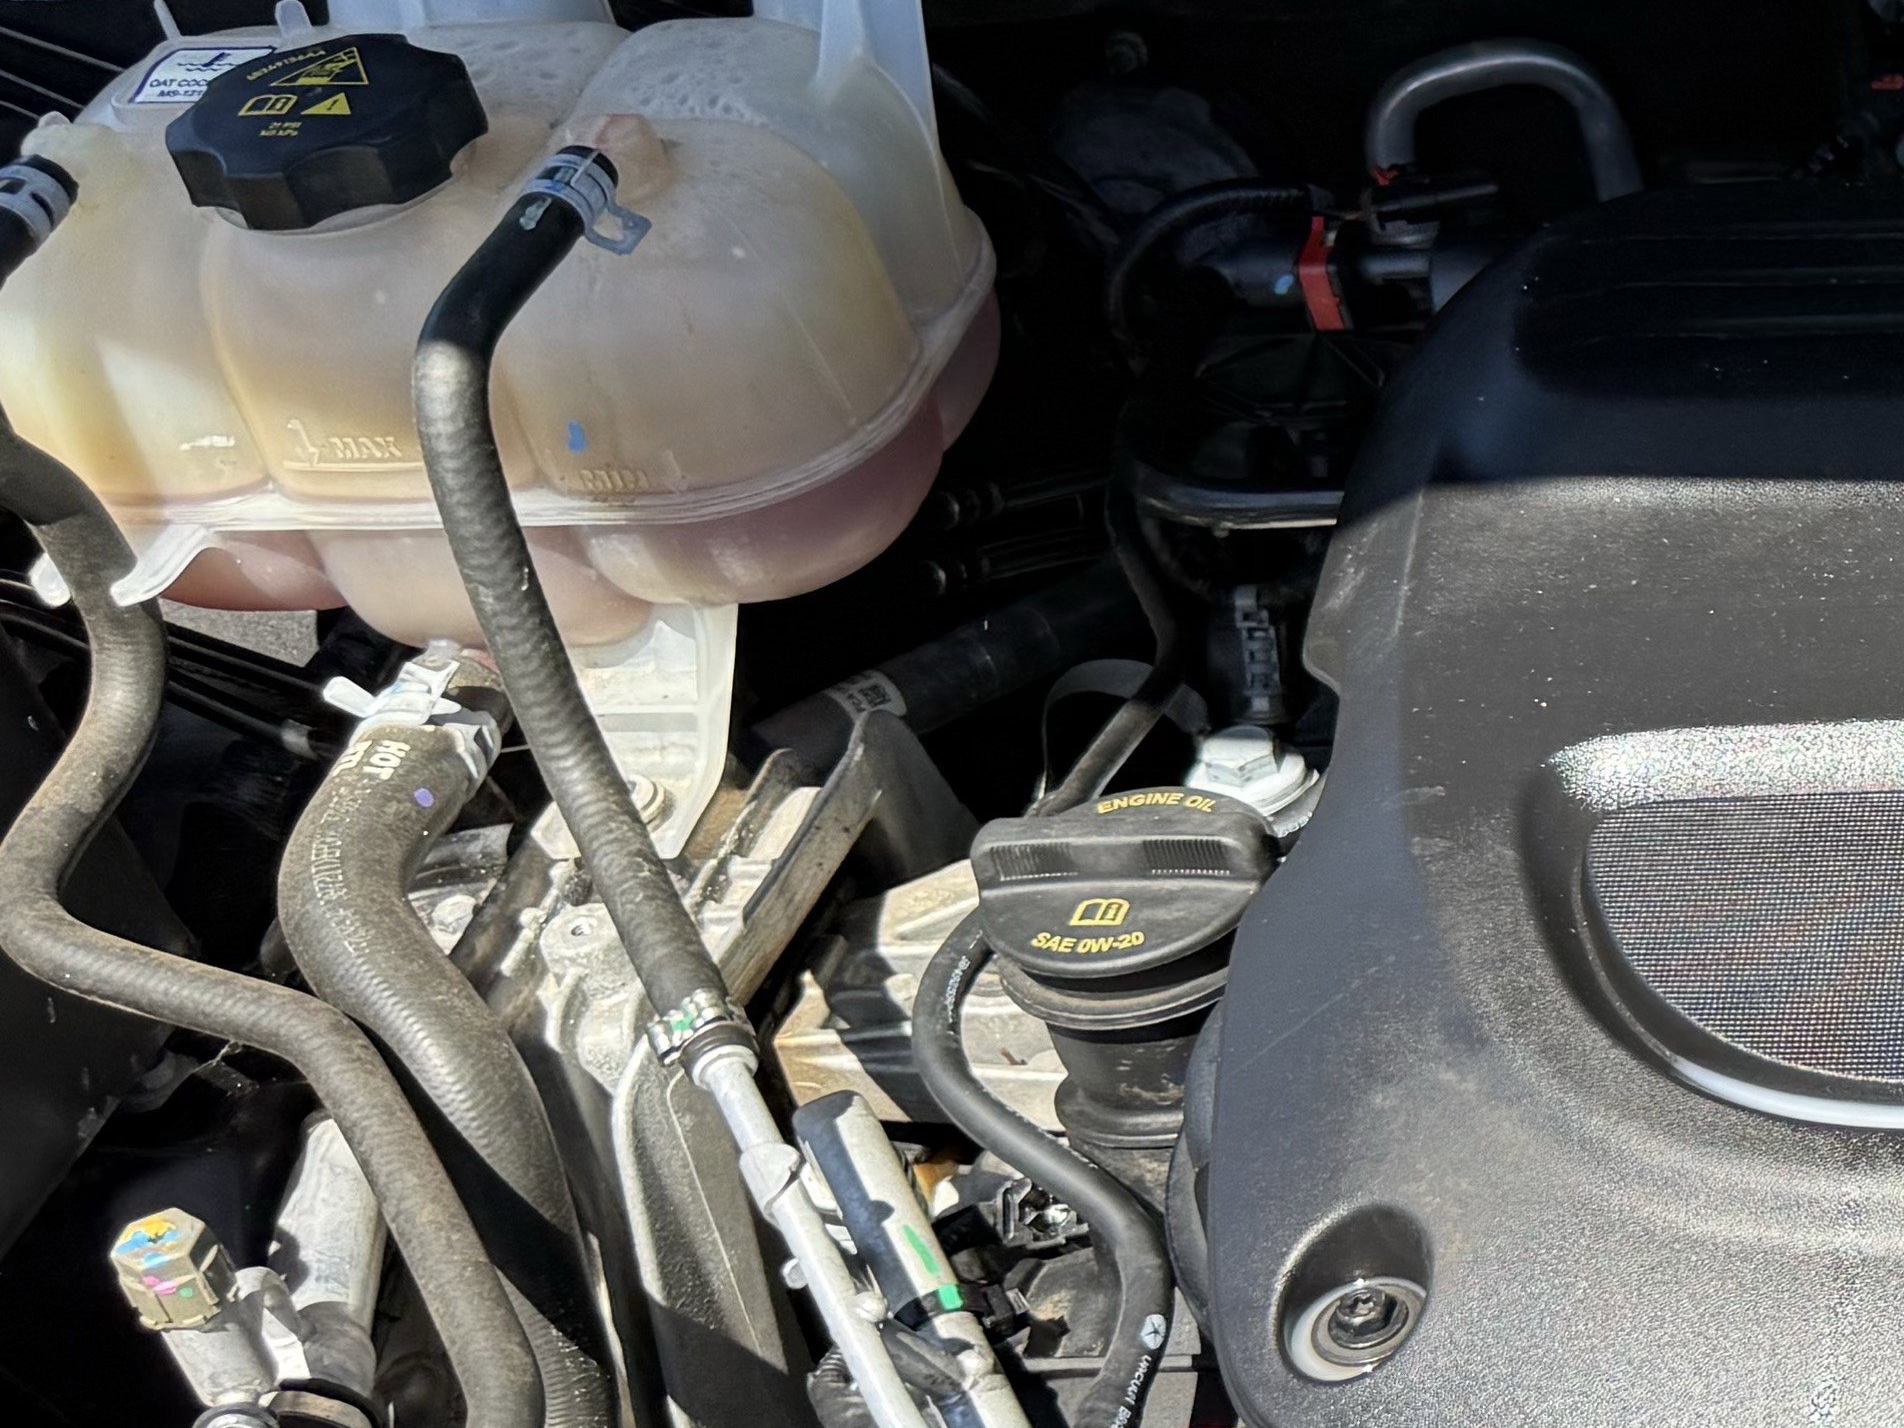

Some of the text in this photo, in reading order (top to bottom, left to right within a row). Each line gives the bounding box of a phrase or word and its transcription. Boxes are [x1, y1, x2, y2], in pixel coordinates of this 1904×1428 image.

[329, 436, 403, 459] MAX
[362, 739, 411, 781] HOT
[1096, 793, 1217, 814] ENGINE OIL
[1031, 932, 1077, 954] SAE
